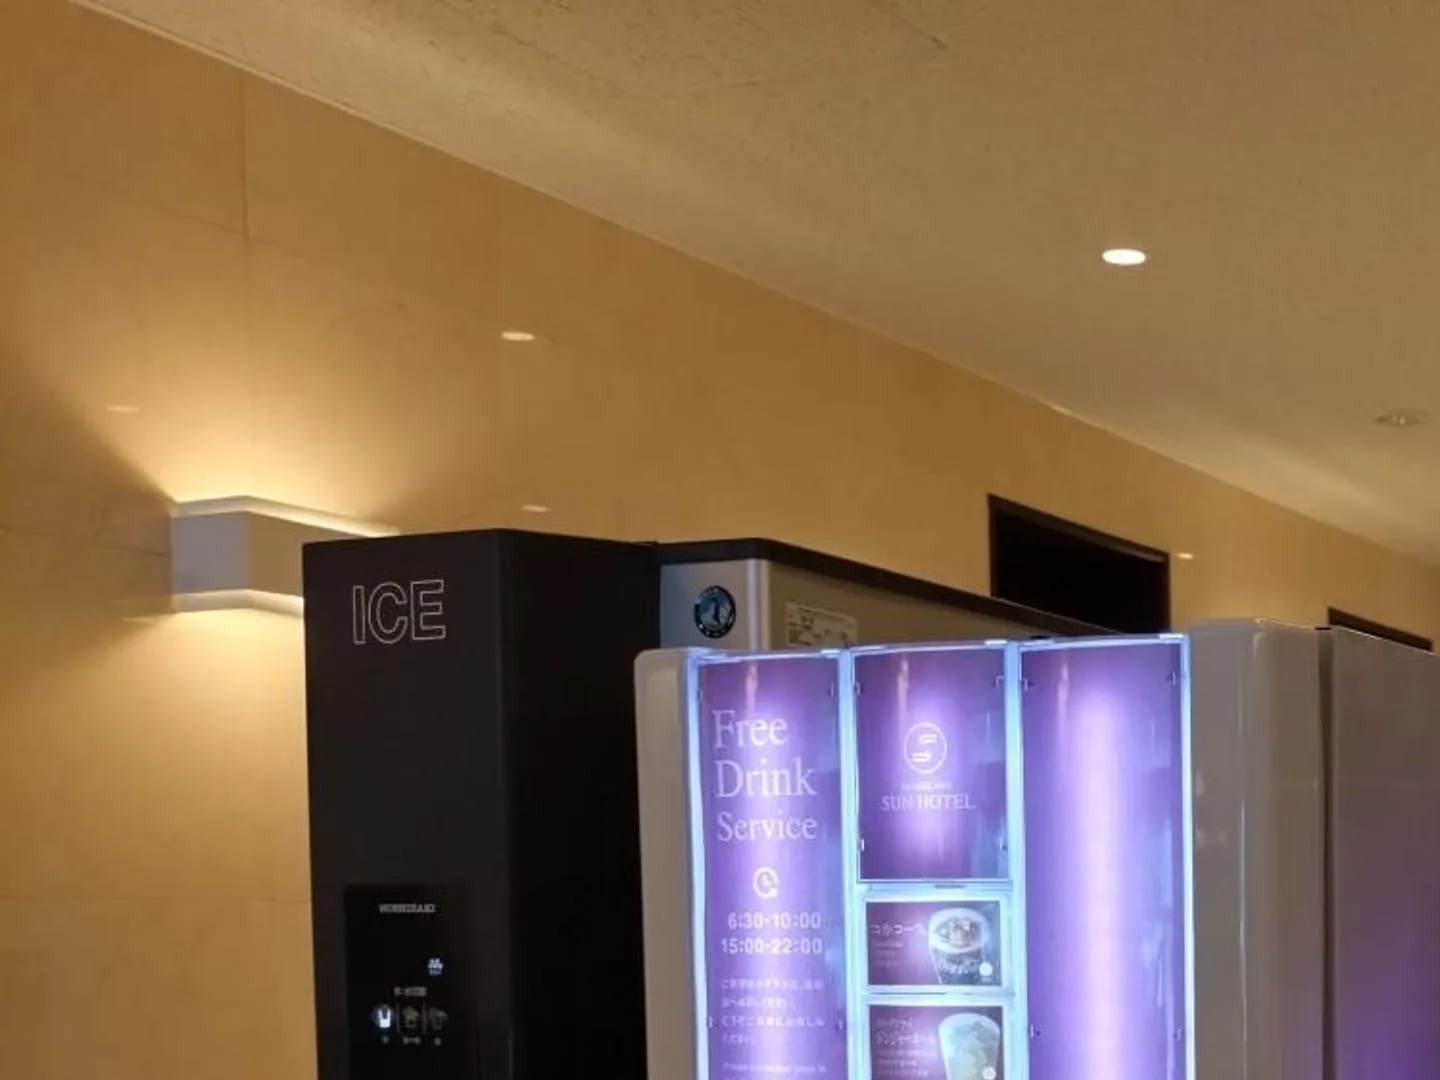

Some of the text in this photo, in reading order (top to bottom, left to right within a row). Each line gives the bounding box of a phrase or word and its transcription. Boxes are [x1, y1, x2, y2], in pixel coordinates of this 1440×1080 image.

[353, 579, 446, 645] ICE
[712, 709, 788, 748] Free
[713, 756, 818, 798] Drink
[882, 793, 976, 812] SUN HOTEL
[717, 811, 819, 842] Service
[727, 911, 822, 930] 6:30-10:00
[720, 937, 823, 954] 15:00-22:00
